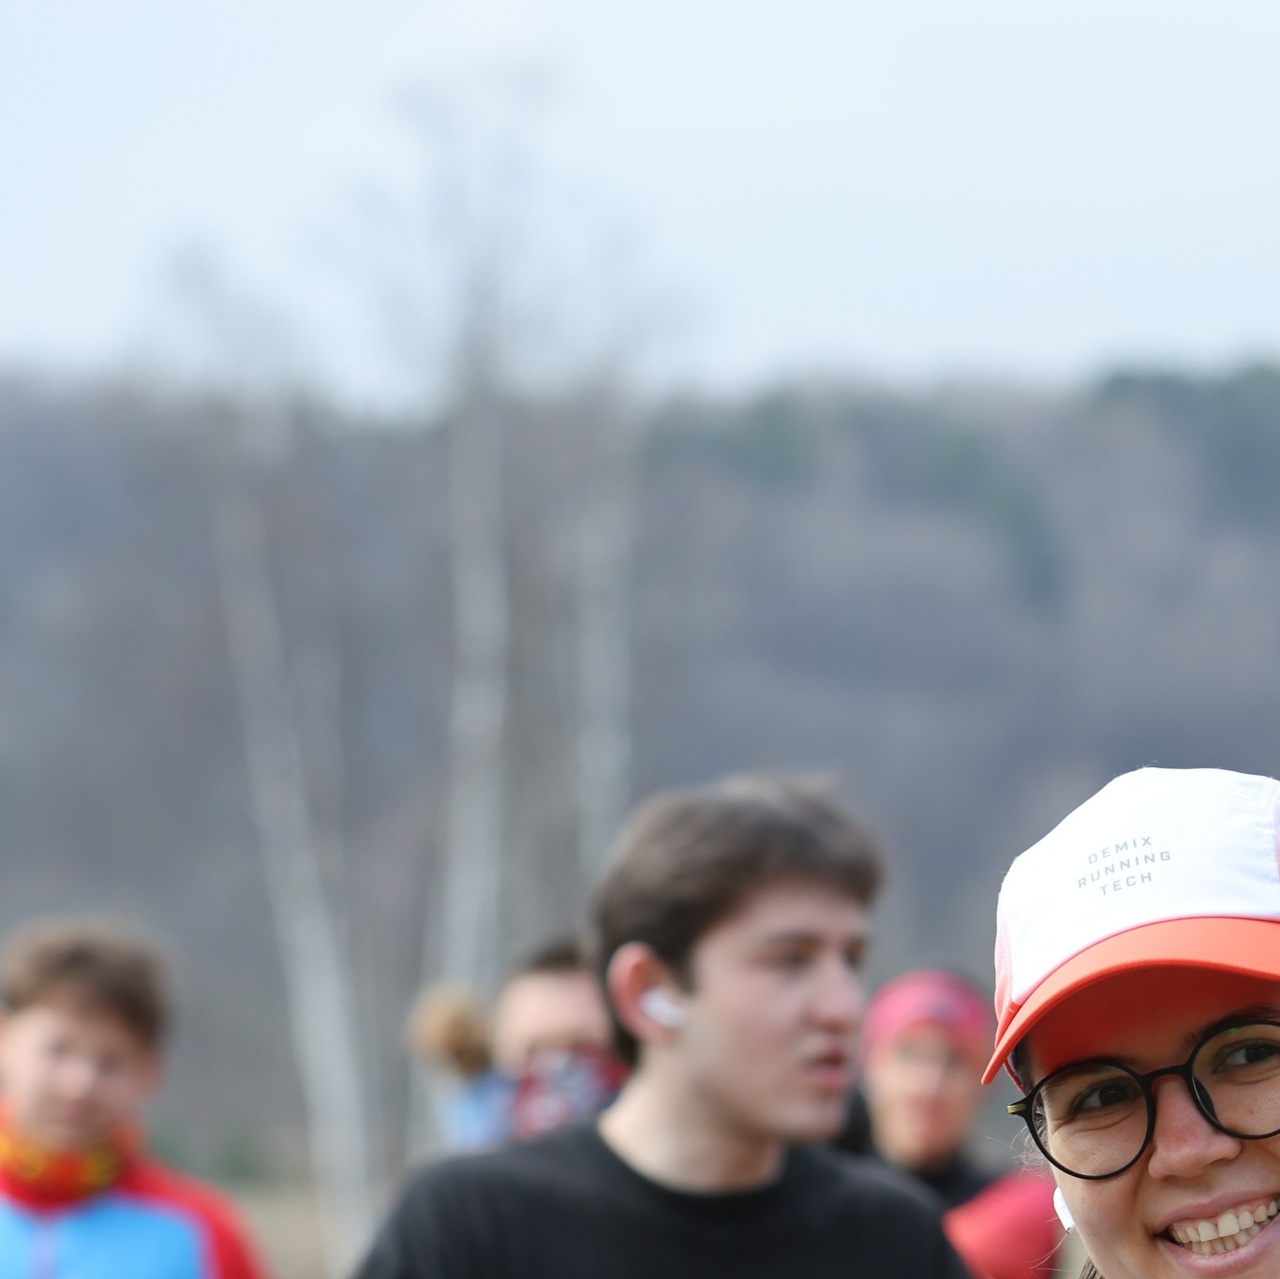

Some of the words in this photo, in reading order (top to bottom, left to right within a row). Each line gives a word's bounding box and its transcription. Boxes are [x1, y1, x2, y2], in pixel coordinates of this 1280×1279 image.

[1088, 836, 1152, 865] DEMIX
[1078, 851, 1171, 889] RUNNING
[1100, 872, 1152, 896] TECH
